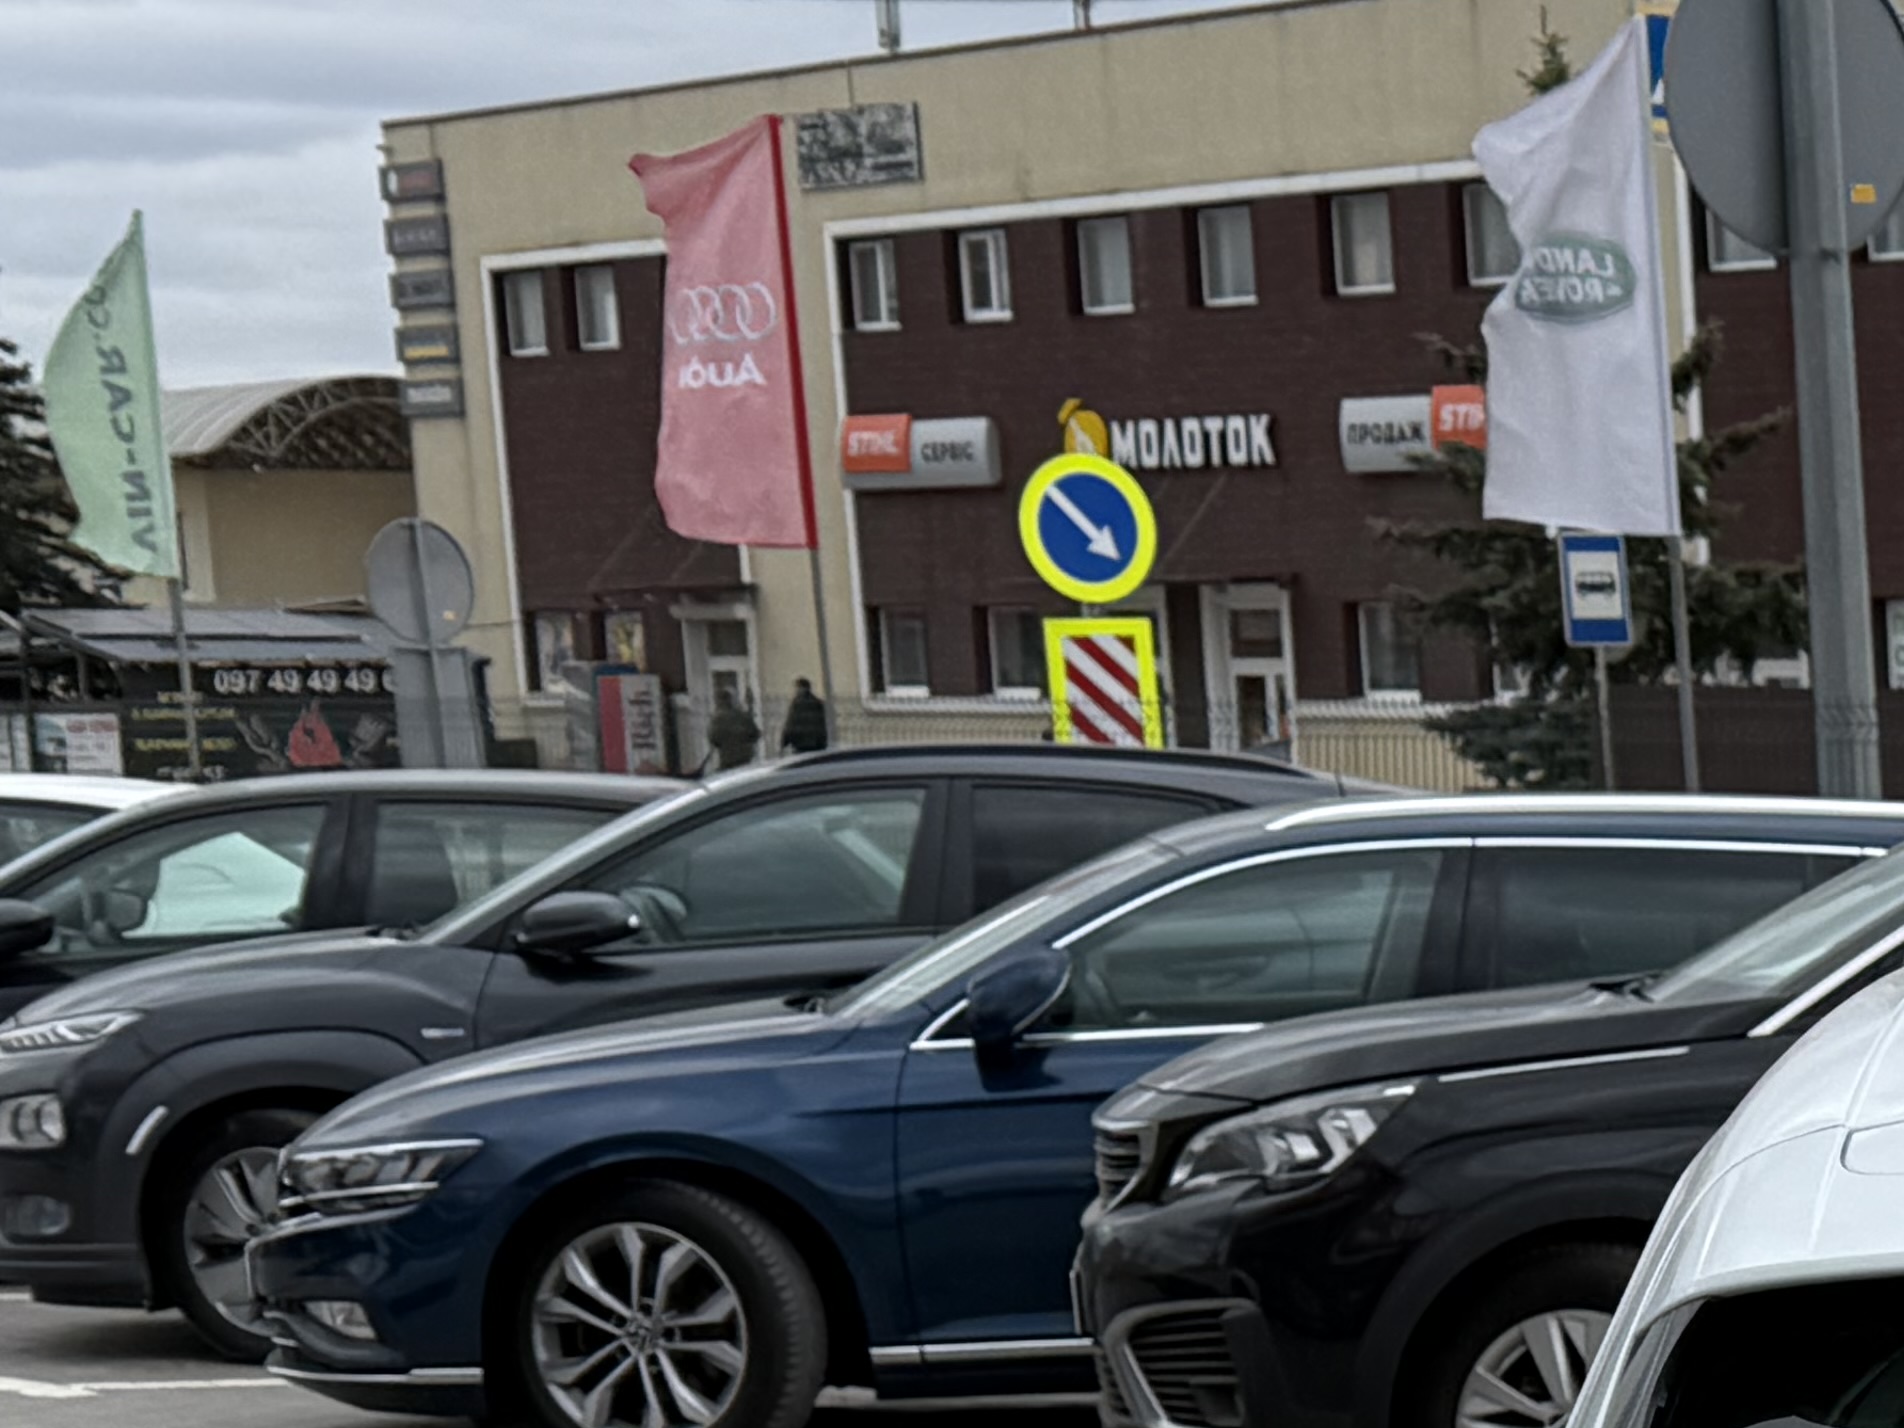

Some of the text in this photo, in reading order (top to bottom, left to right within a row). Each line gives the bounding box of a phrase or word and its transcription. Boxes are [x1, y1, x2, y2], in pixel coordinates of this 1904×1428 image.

[1439, 403, 1485, 432] STI
[848, 430, 898, 456] STIHL
[1110, 413, 1276, 470] МОЛОТОК
[1347, 420, 1425, 445] ПРОДАЖ
[213, 669, 261, 695] 097
[267, 669, 300, 694] 49
[307, 669, 340, 694] 49
[345, 668, 379, 694] 49
